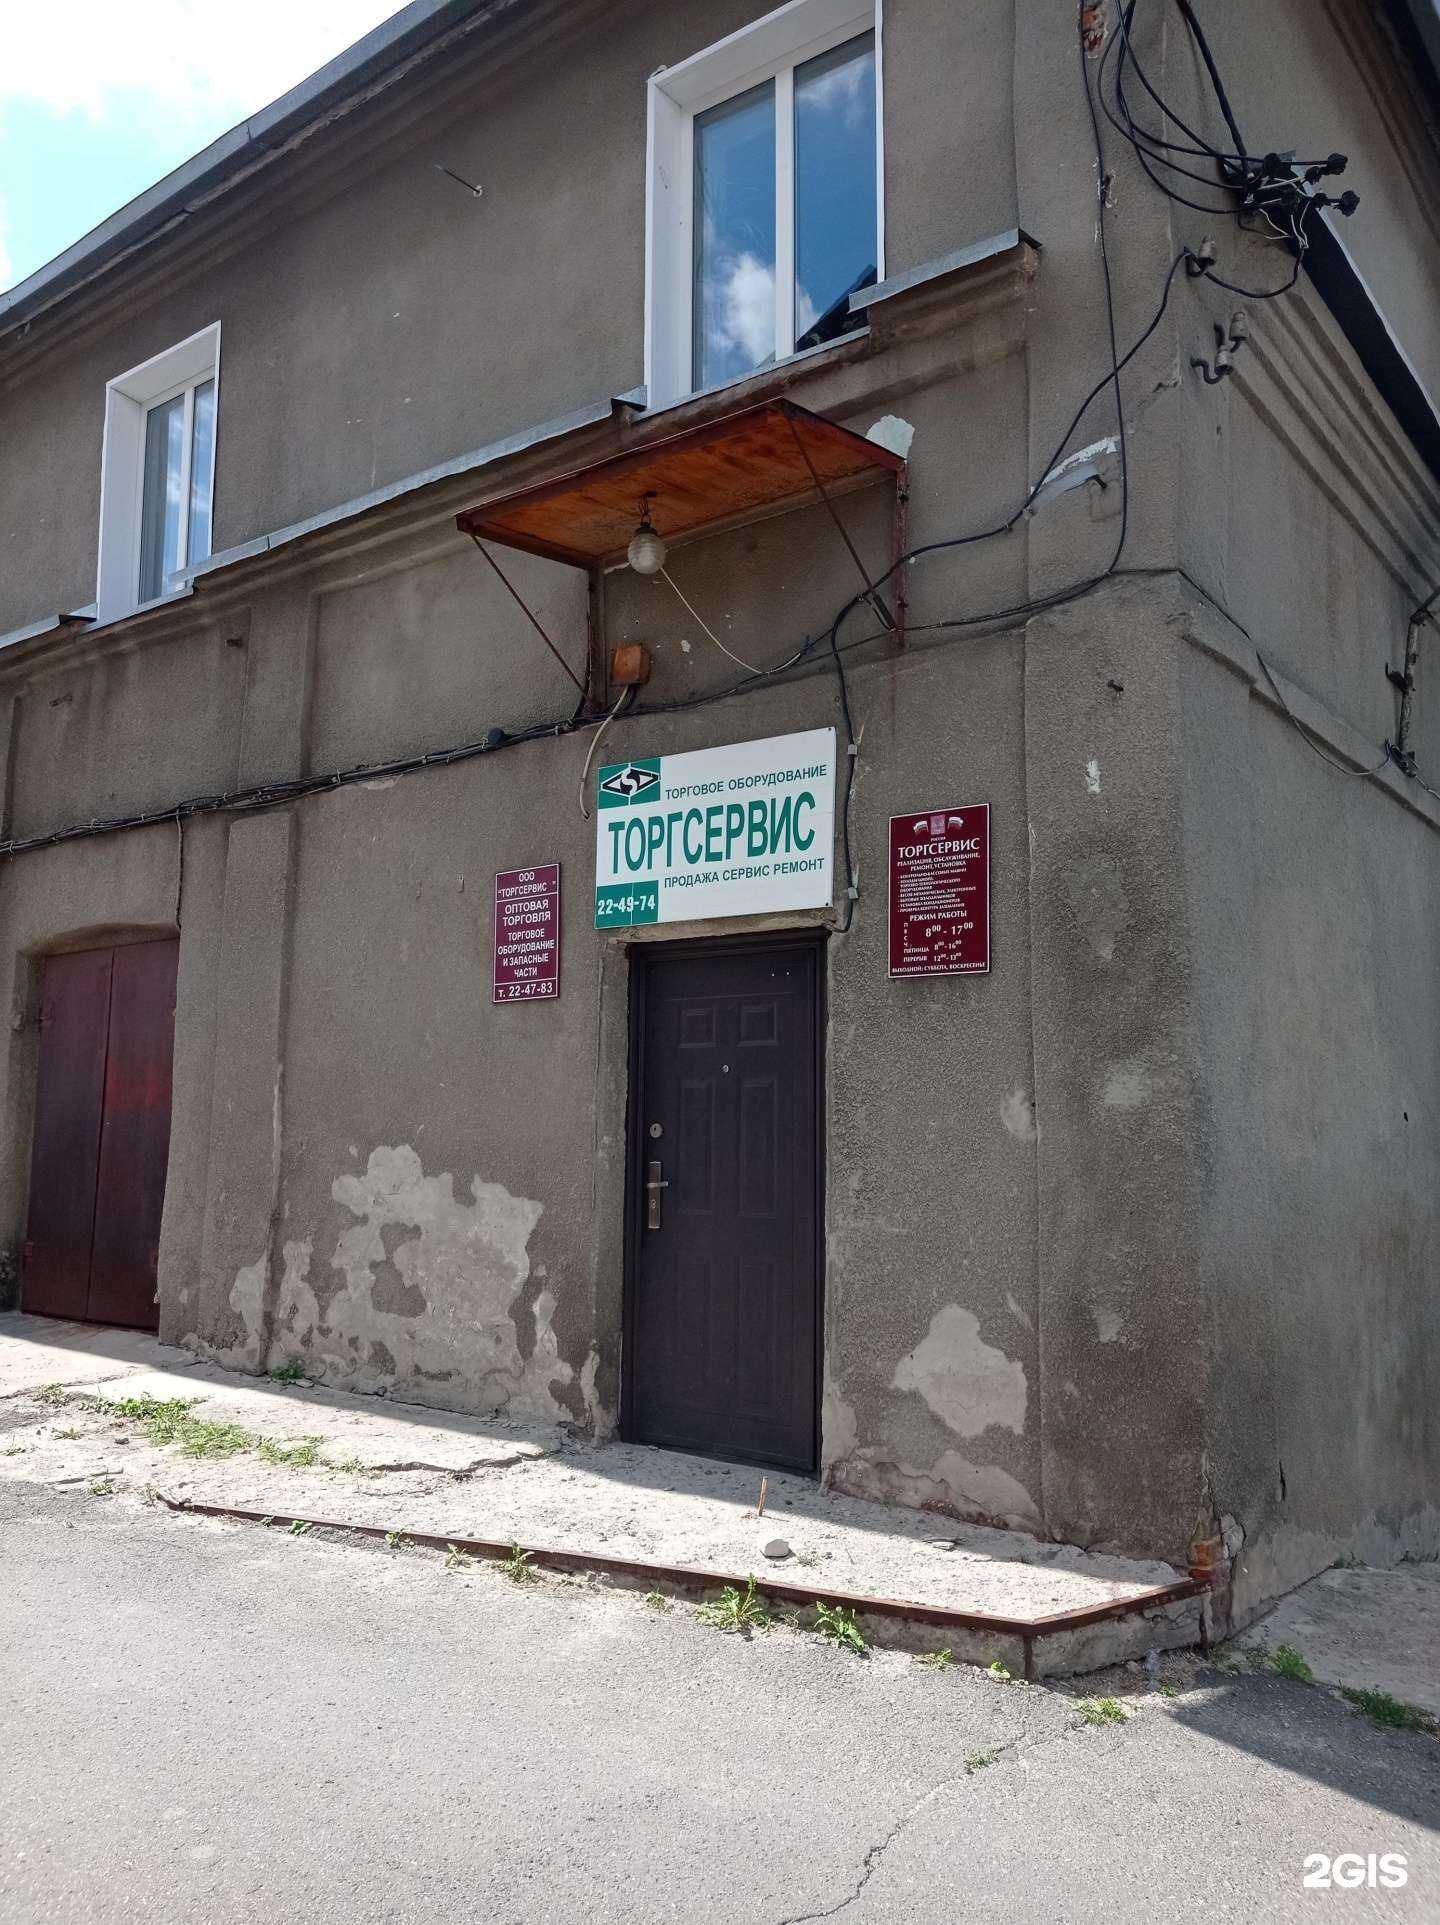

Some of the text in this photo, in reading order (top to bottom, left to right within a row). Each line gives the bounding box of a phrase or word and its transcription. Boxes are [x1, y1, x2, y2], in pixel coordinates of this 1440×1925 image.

[666, 764, 827, 800] ТОРГОВОЕ ОБОРУДОВАНИЕ
[608, 791, 816, 874] ТОРГСЕРВИС
[898, 838, 980, 858] ТОРГСЕРВИС
[518, 871, 534, 882] ООО
[664, 858, 825, 888] ПРОДАЖА СЕРВИС РЕМОНТ
[505, 899, 549, 915] ОПТОВАЯ
[597, 894, 656, 915] 22-49-74
[502, 910, 551, 927] ТОРГОВЛЯ
[910, 911, 968, 922] РЕЖИМ РАБОТЫ
[508, 928, 545, 942] ТОРГОВОЕ
[497, 940, 555, 955] ОБОРУДОВАНИЕ
[502, 953, 549, 967] И ЗАПАСНЫЕ
[514, 967, 538, 978] ЧАСТИ
[508, 982, 553, 997] 22-47-83
